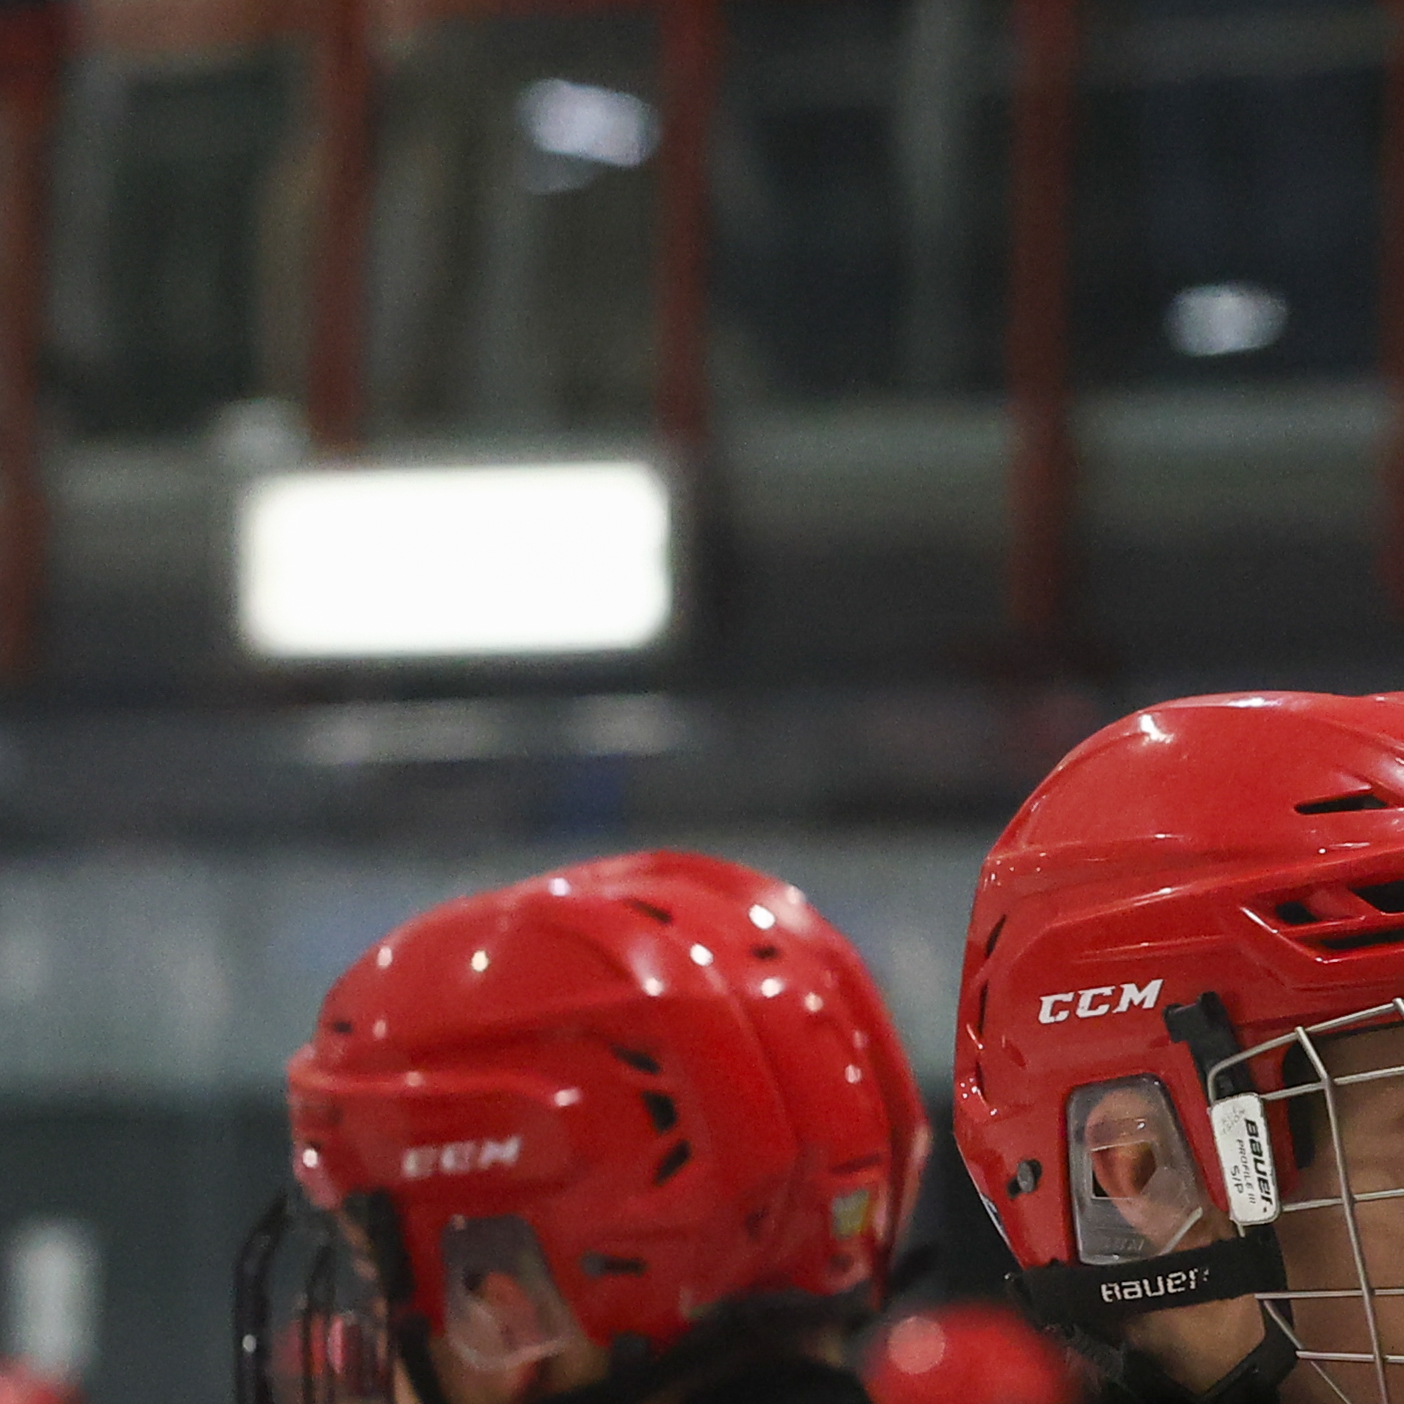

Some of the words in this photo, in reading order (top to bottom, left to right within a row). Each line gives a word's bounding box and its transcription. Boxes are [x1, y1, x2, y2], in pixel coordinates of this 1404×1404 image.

[1038, 978, 1164, 1024] CCM
[1230, 1164, 1245, 1195] S/P
[1235, 1138, 1254, 1190] PROFILE
